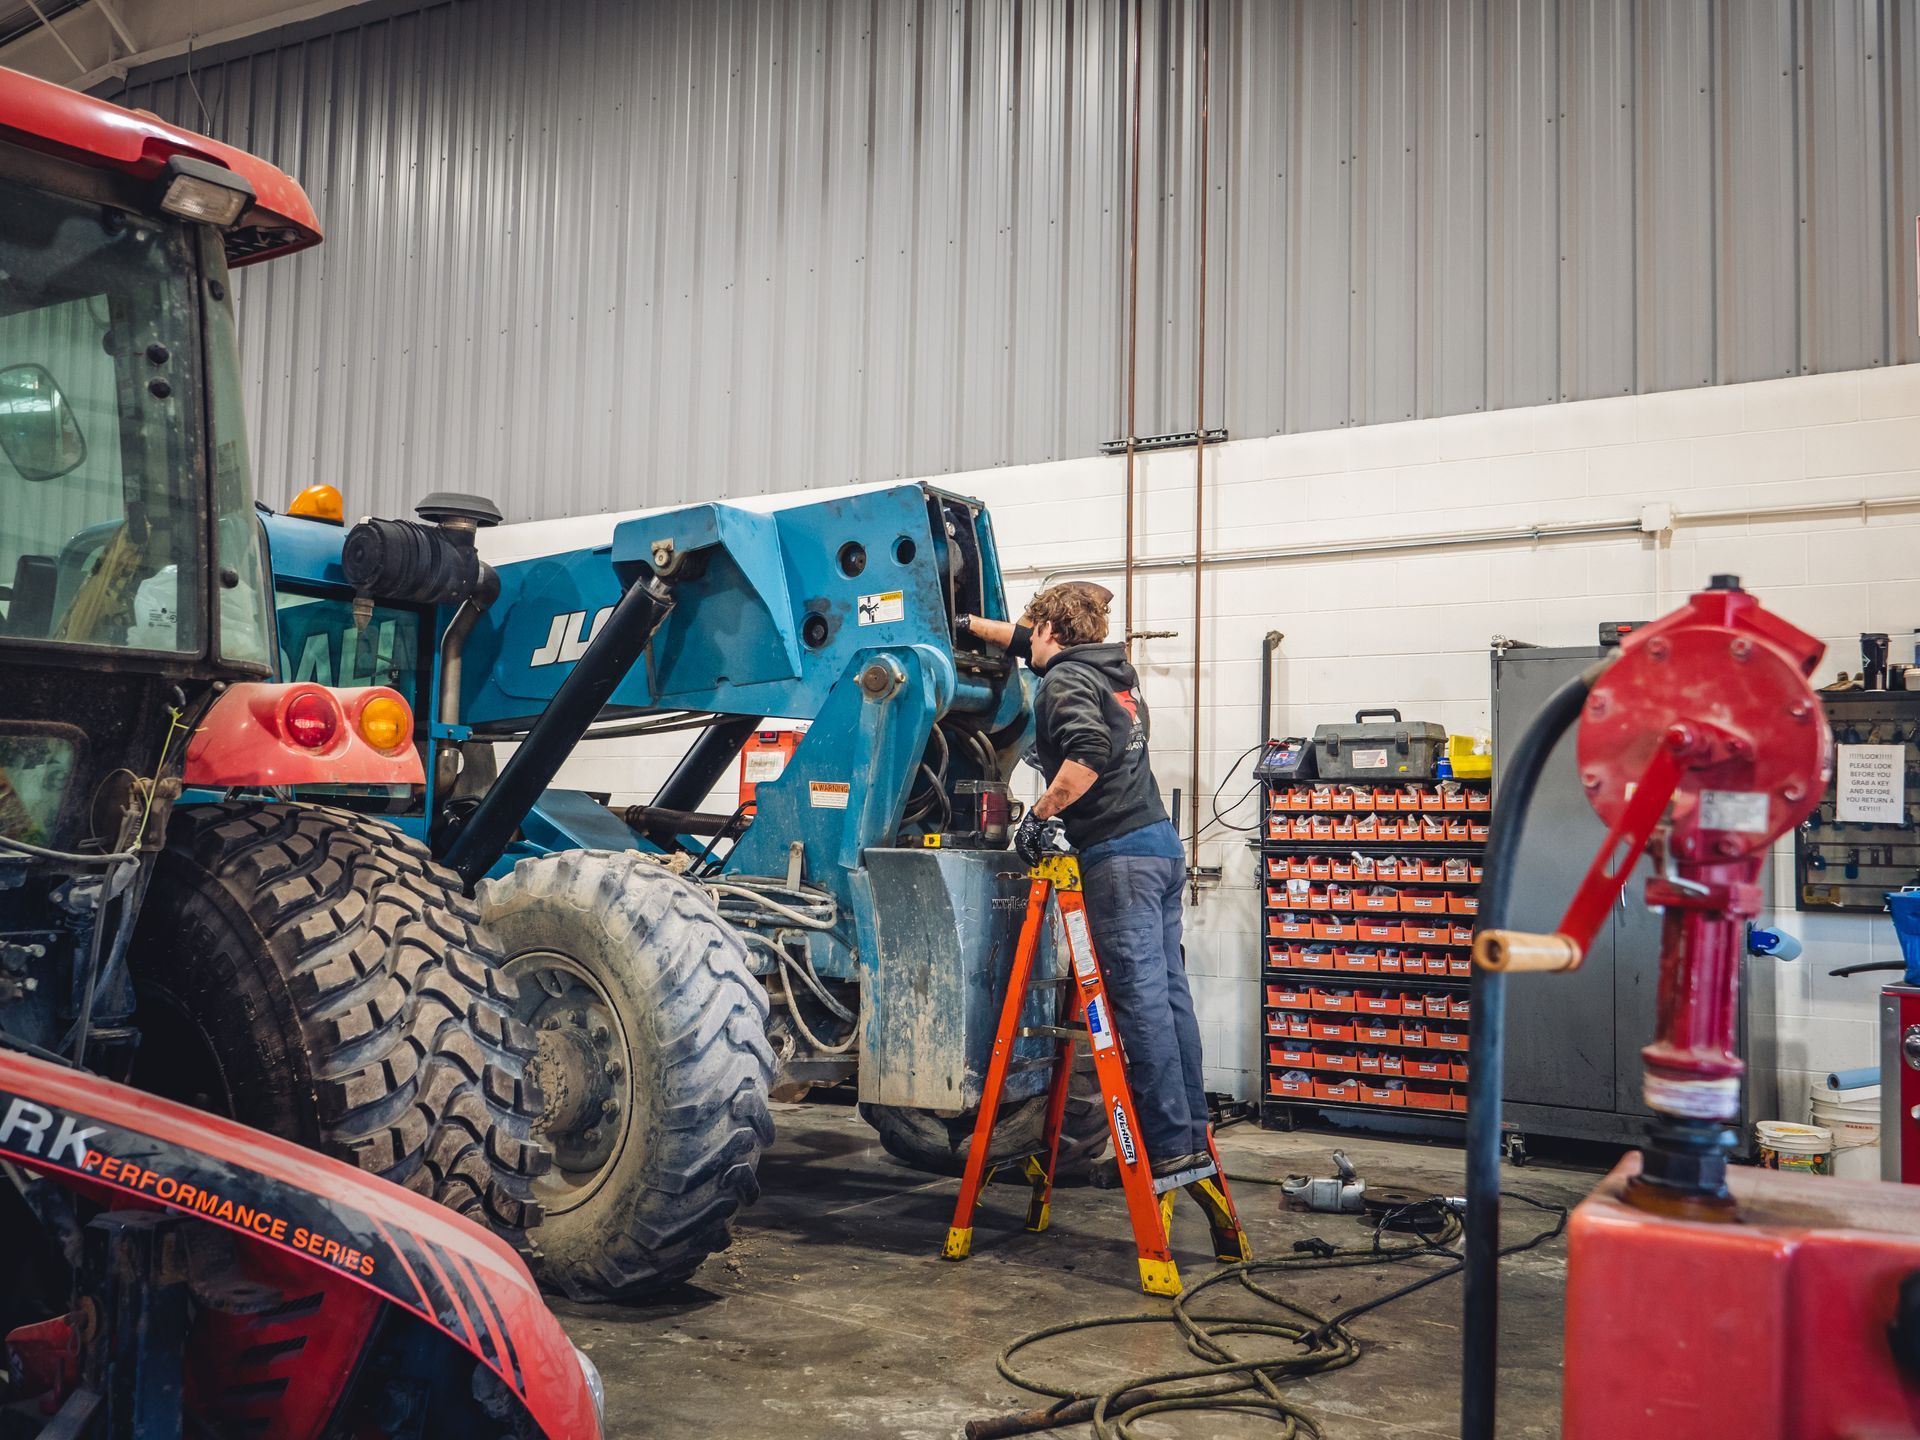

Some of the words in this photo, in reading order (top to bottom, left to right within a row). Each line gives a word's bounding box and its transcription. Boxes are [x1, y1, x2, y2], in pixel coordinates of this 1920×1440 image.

[819, 784, 848, 793] WARNING
[0, 1097, 106, 1169] RK
[82, 1149, 287, 1240] PERFORMANCE
[293, 1226, 376, 1277] SERIES
